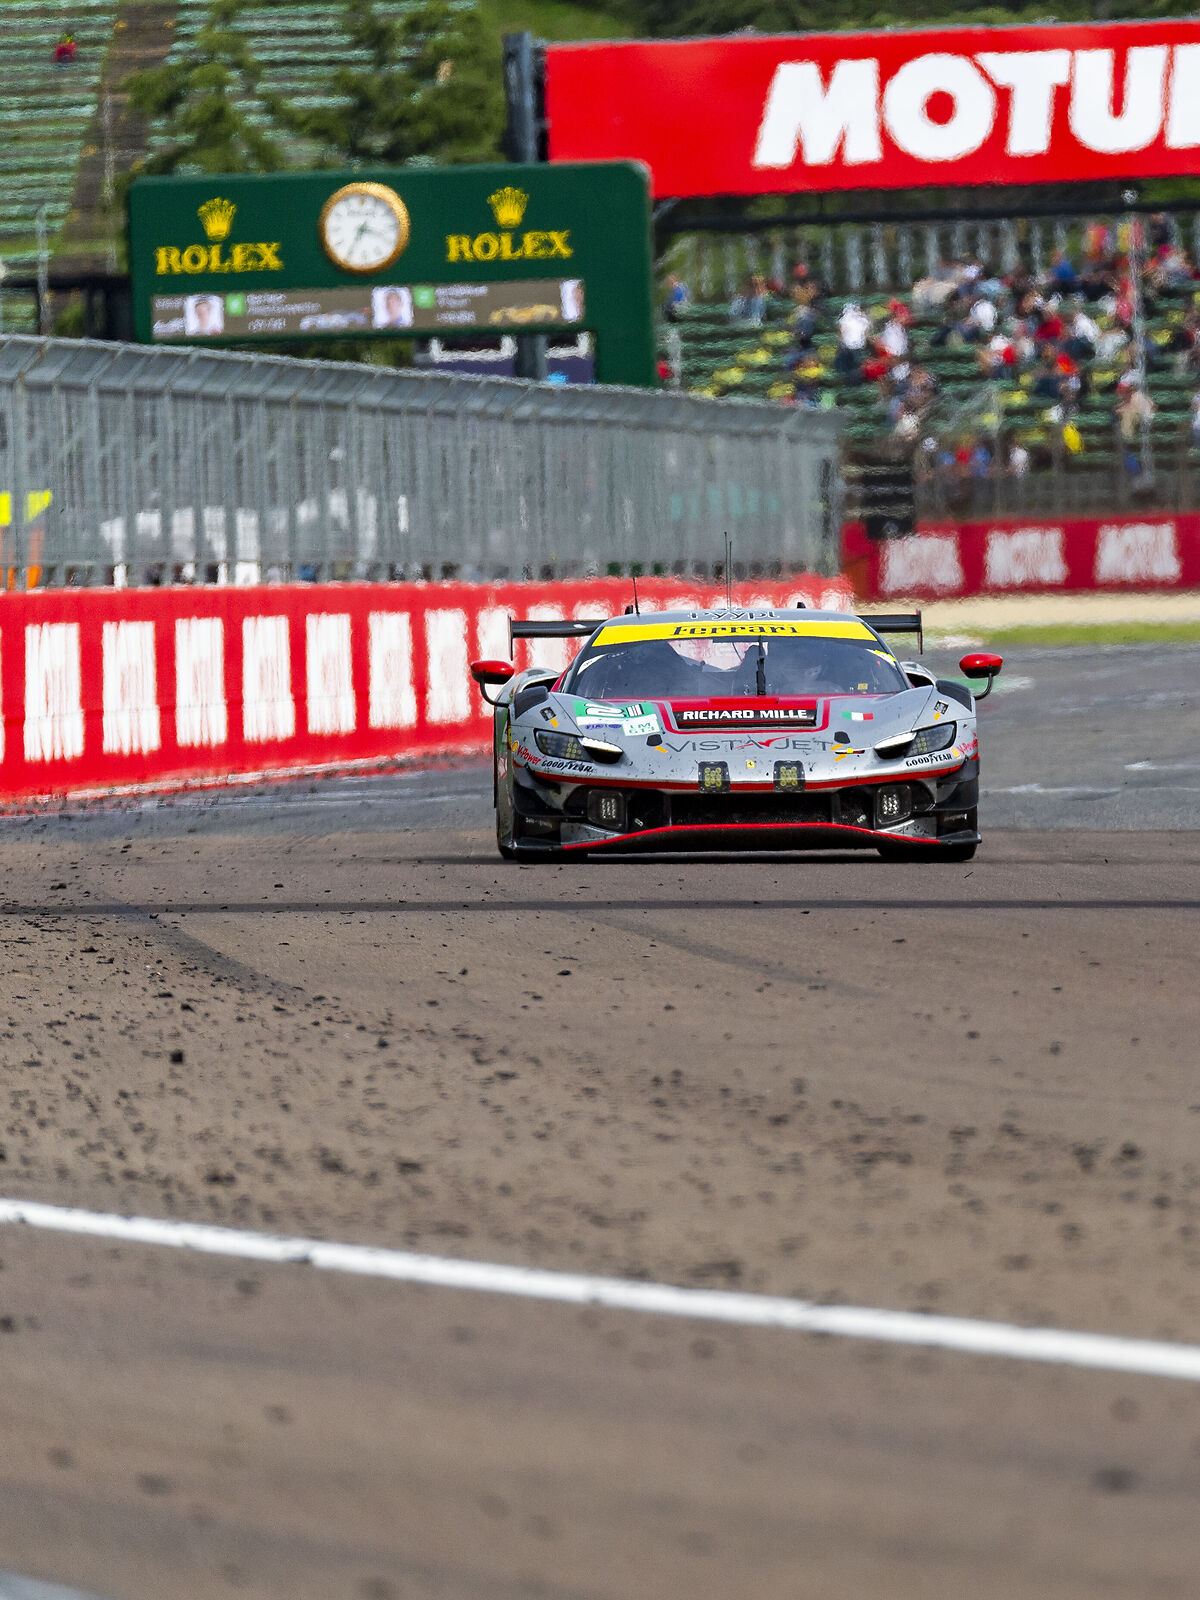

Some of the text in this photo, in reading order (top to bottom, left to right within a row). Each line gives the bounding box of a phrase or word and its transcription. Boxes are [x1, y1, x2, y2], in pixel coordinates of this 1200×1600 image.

[448, 230, 573, 262] ROLEX
[156, 242, 283, 275] ROLEX
[673, 624, 800, 636] Ferrari
[683, 709, 808, 720] RICHARD MILLE
[517, 746, 542, 765] V-Power
[905, 752, 953, 767] GOODYEAR
[541, 759, 593, 773] GOODYEAR
